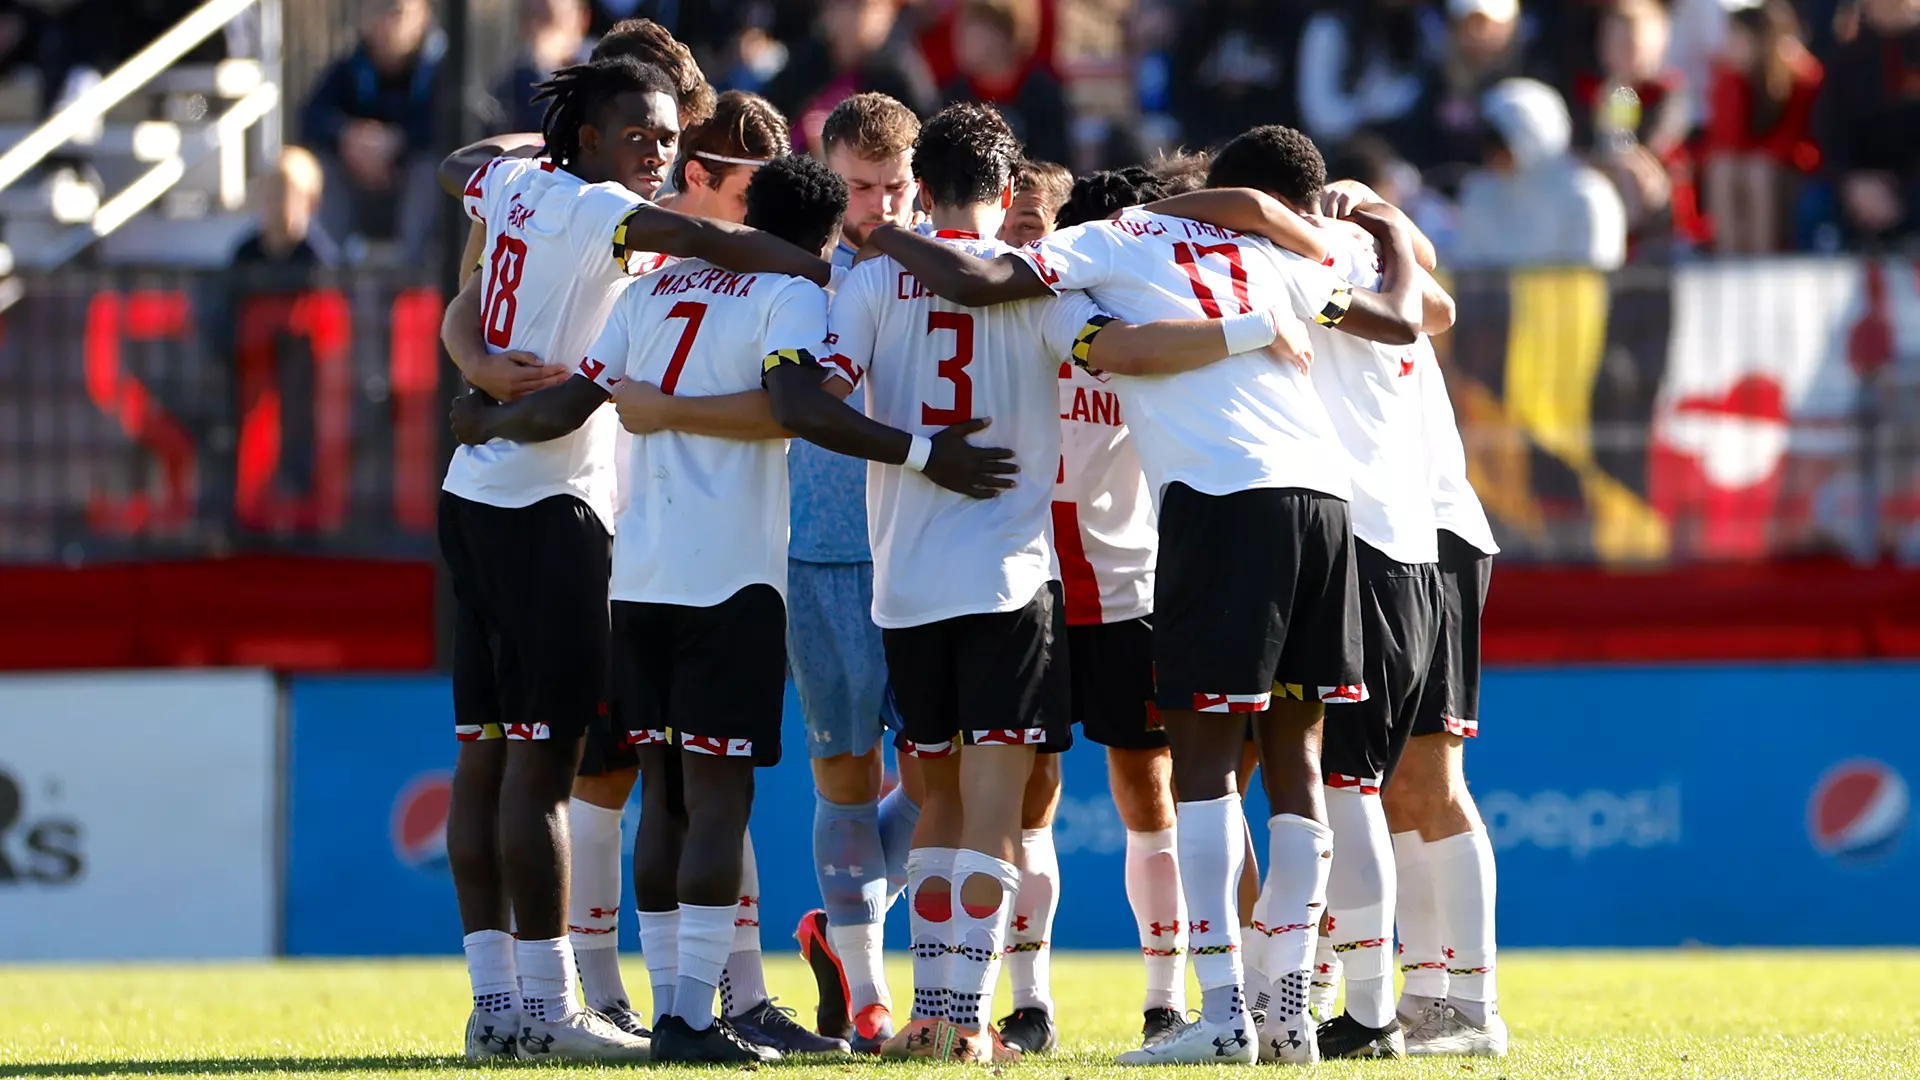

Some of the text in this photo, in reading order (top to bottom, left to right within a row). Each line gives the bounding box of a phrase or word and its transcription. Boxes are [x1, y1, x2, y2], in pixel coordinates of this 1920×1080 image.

[480, 231, 528, 349] 18
[1172, 242, 1254, 319] 17
[660, 301, 708, 396] 7
[922, 311, 974, 426] 3
[1483, 783, 1682, 861] pepsi
